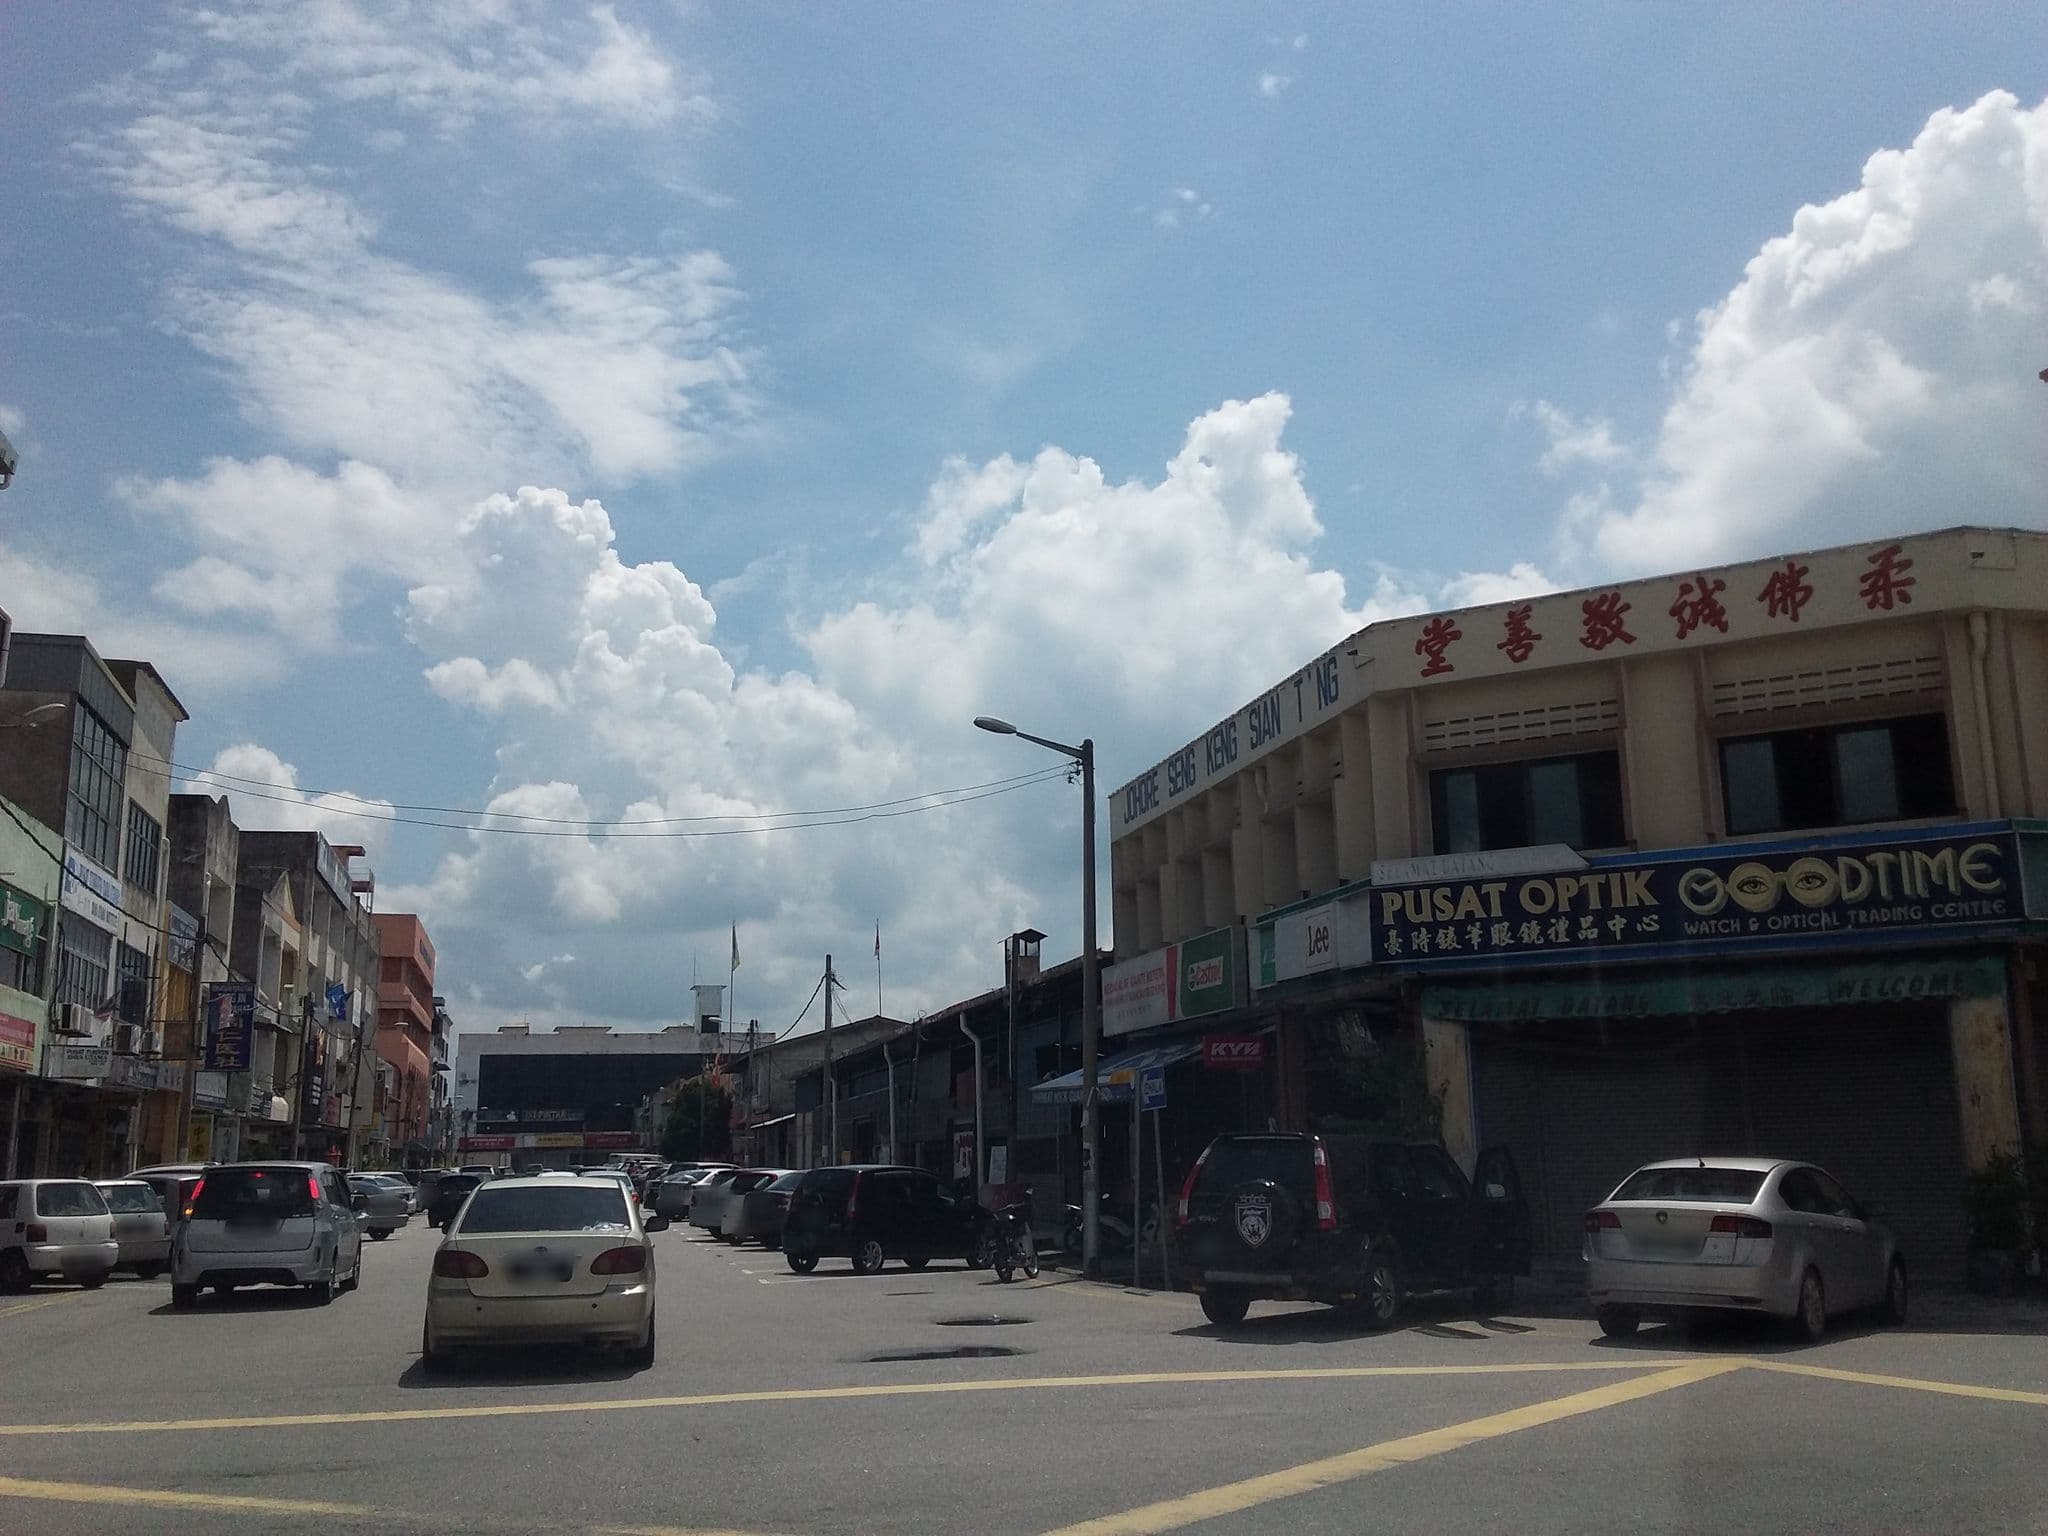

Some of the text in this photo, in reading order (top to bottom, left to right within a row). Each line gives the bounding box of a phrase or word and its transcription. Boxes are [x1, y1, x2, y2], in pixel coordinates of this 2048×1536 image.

[1123, 771, 1160, 824] JOHORE
[1167, 749, 1196, 797] SENG
[1206, 721, 1238, 776] KENG
[1249, 693, 1281, 750] SIAN
[1381, 869, 1660, 925] PUSAT OPTIK
[1684, 900, 2007, 936] WATCH & OPTICAL TRADING CENTRE
[1307, 925, 1330, 956] Lee
[1838, 973, 1966, 998] WELCOME
